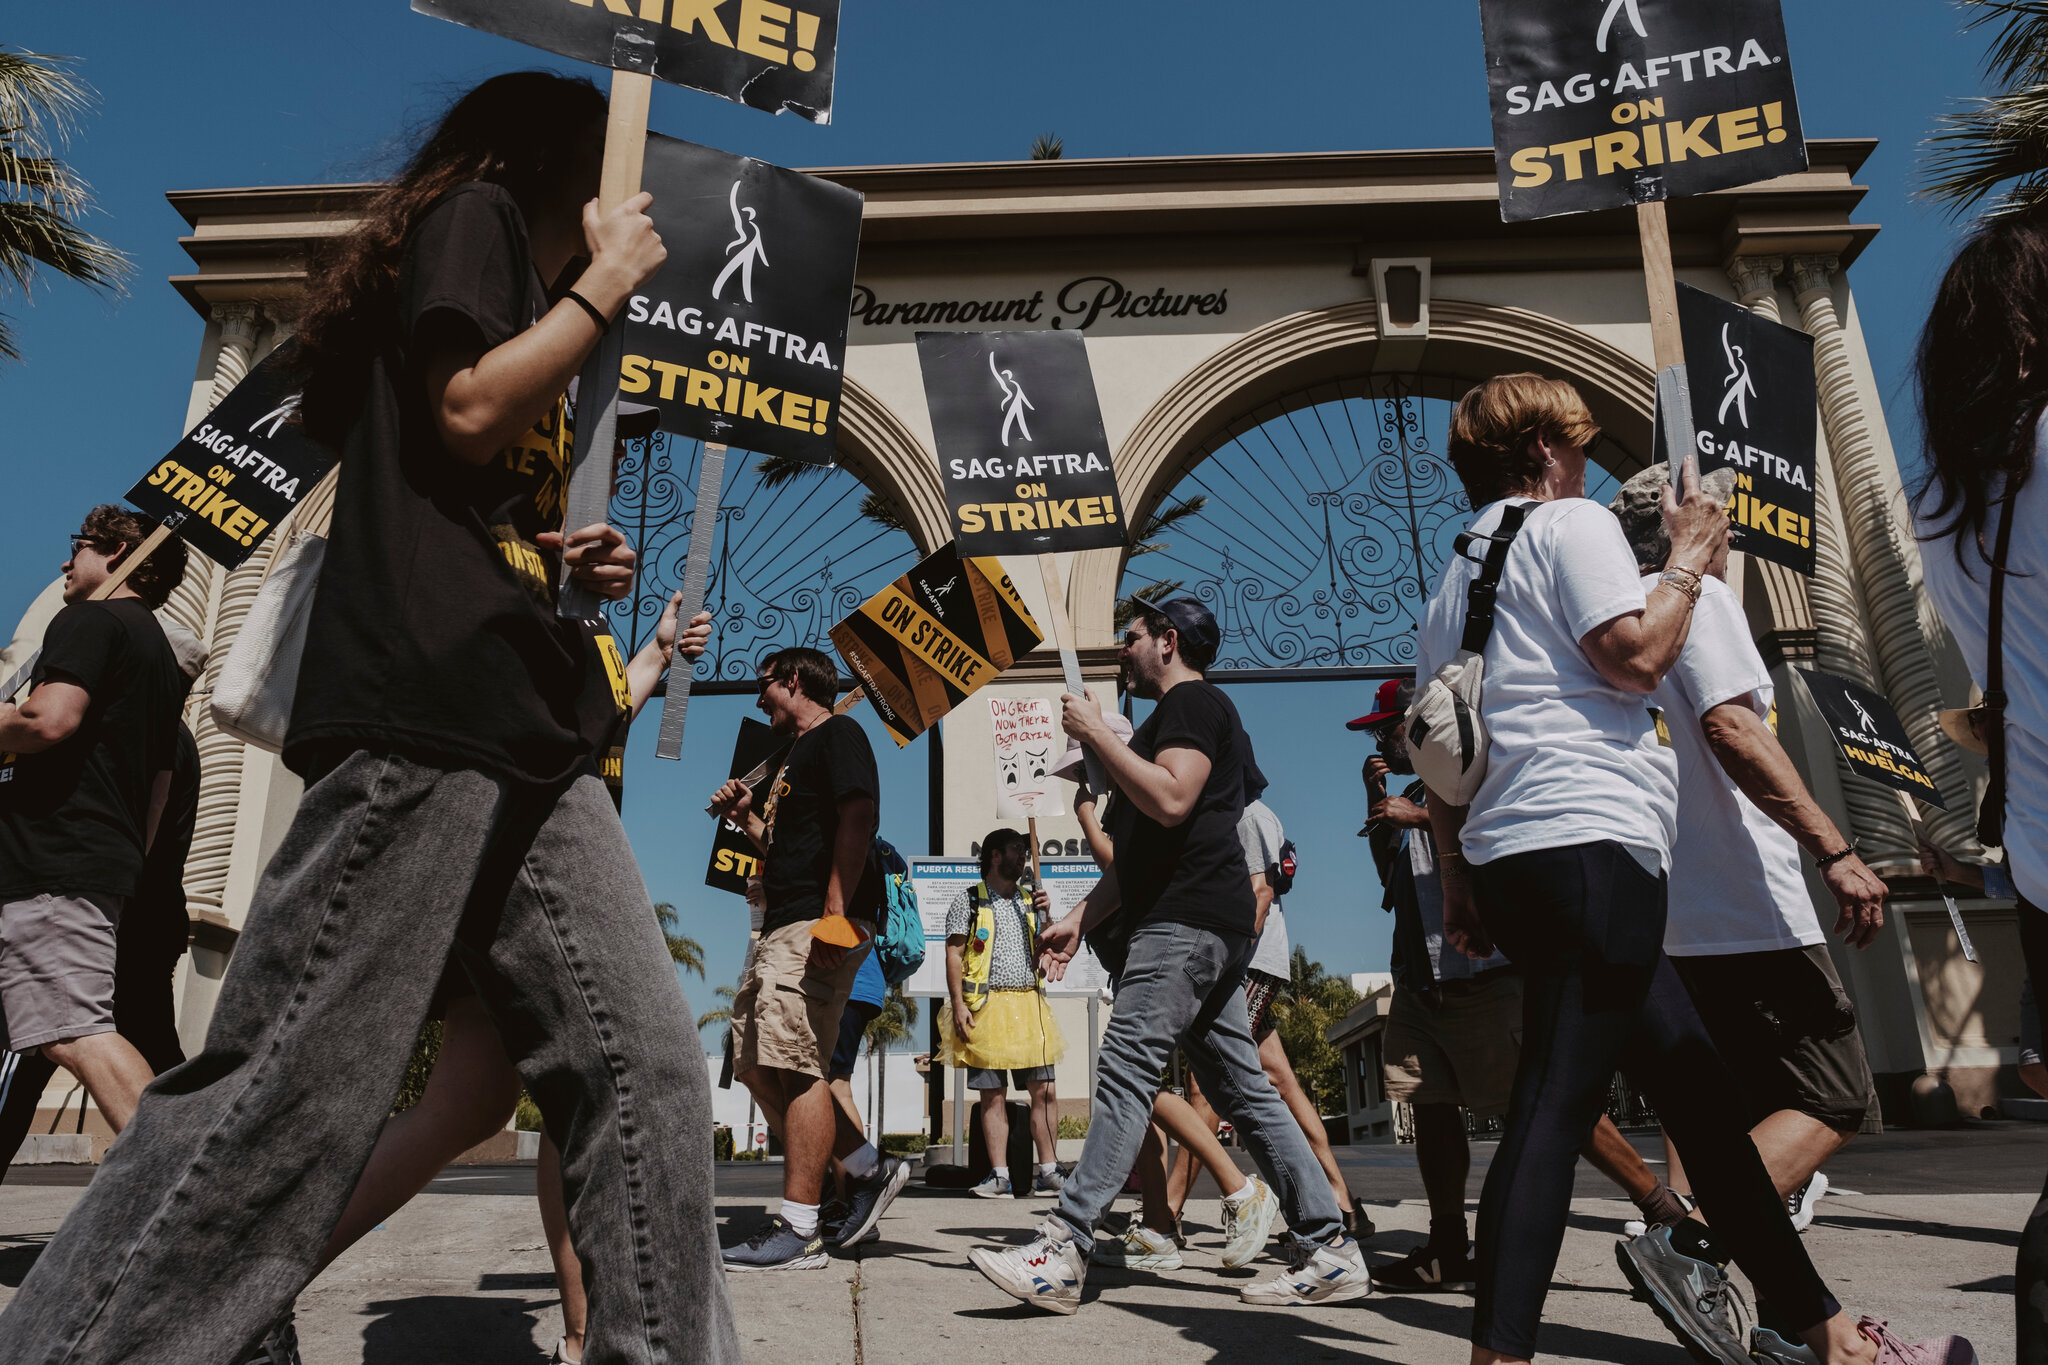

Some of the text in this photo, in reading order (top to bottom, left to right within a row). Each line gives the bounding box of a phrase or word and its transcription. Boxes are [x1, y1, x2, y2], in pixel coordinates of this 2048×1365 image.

[1611, 97, 1665, 124] ON
[1510, 100, 1788, 188] STRIKE!
[850, 275, 1228, 330] Paramount Pictures
[707, 350, 750, 375] ON
[619, 354, 831, 436] STRIKE!
[207, 464, 236, 488] ON
[1734, 472, 1753, 492] N
[147, 460, 270, 547] STRIKE!
[1016, 482, 1048, 499] ON
[957, 496, 1117, 533] STRIKE!
[881, 595, 983, 687] ON STRIKE
[848, 651, 896, 720] #SAGAFTRASTRONG
[991, 699, 1040, 717] OH GREAT
[995, 719, 1017, 731] NOW
[995, 732, 1018, 746] BOTH
[1843, 744, 1935, 790] HUELGA!
[1877, 748, 1893, 760] EN
[916, 865, 953, 874] PUERTA
